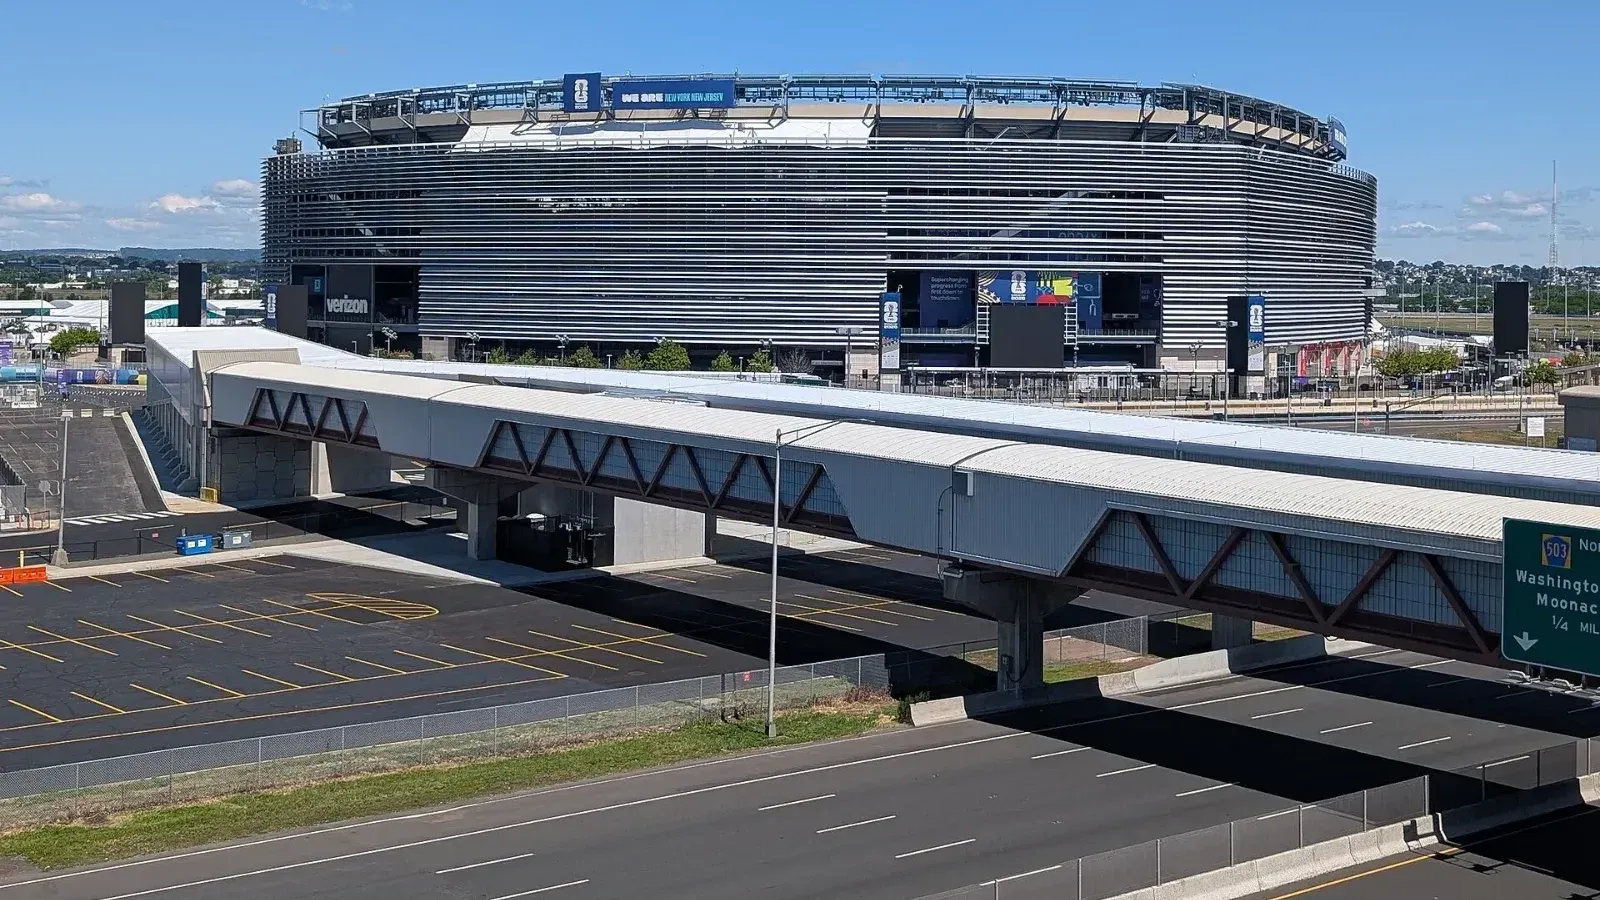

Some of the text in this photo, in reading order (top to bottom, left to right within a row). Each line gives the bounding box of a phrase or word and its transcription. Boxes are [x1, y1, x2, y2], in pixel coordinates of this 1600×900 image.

[622, 92, 724, 102] WE ARE NEW YORK NEW JERSEY
[327, 294, 368, 313] verizon
[1546, 538, 1600, 558] 503 No
[1516, 569, 1599, 595] Washingto
[1537, 592, 1598, 614] Moonac
[1580, 622, 1600, 634] MIL
